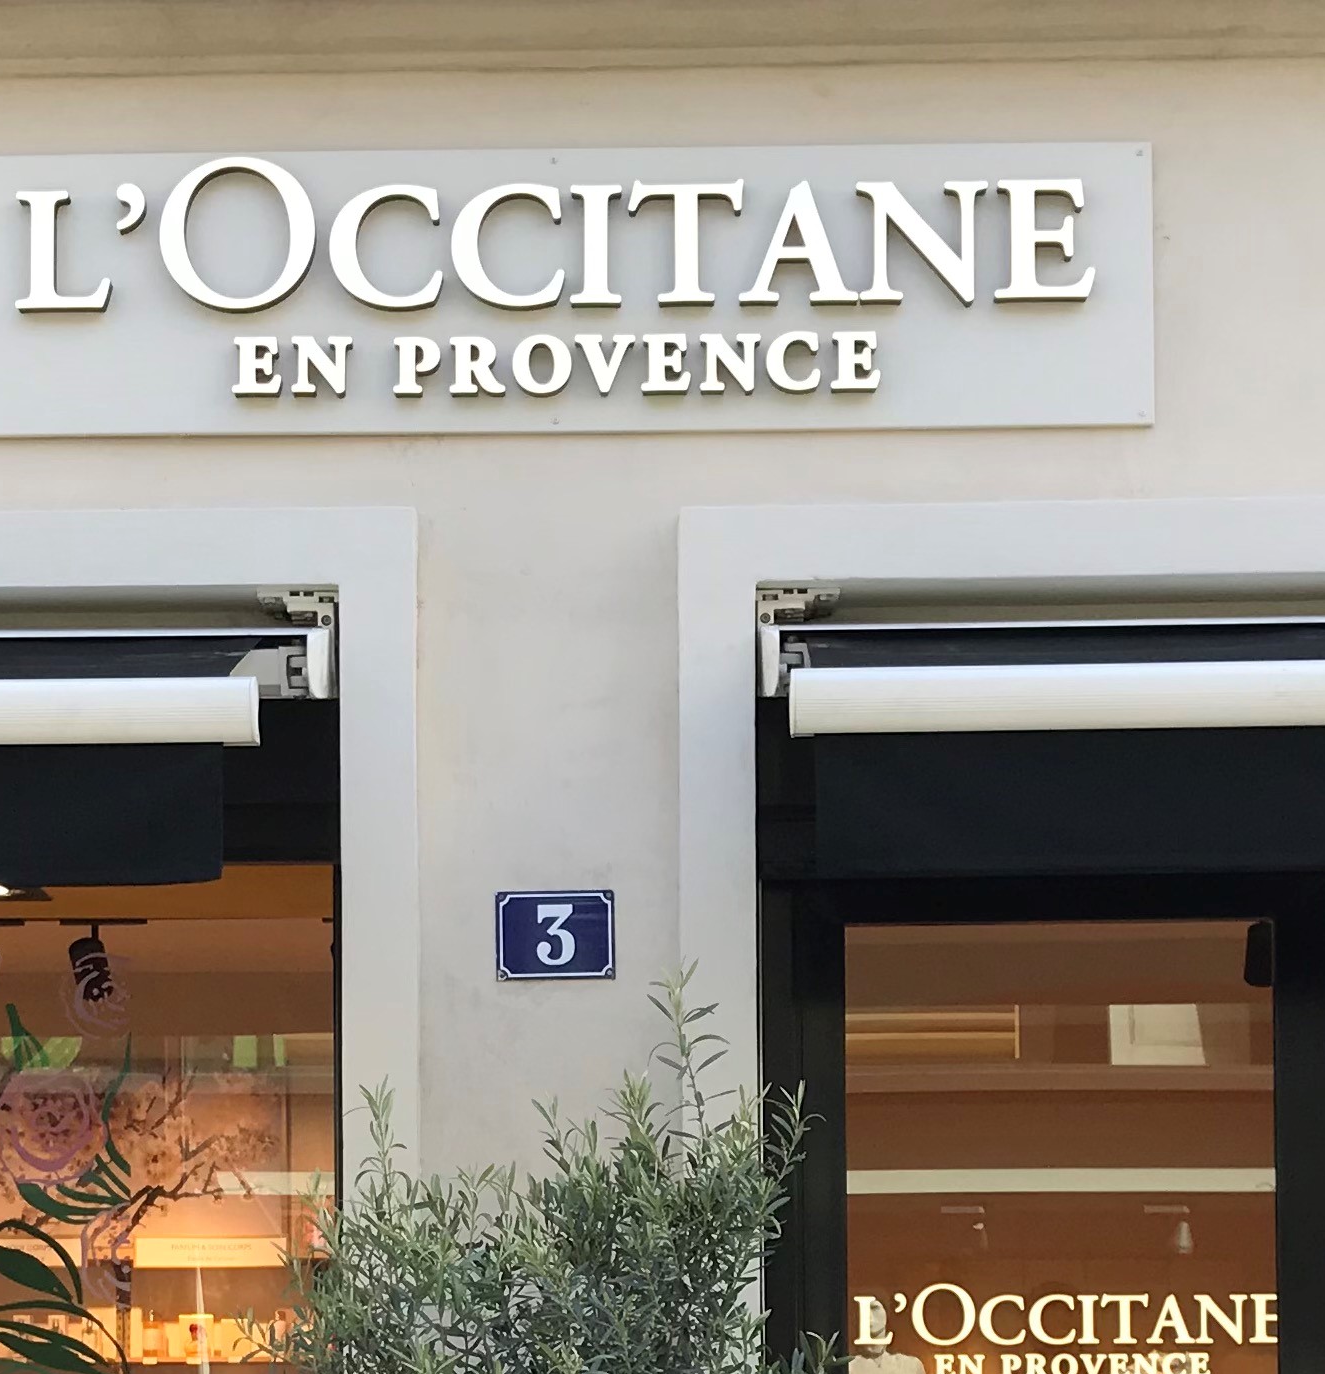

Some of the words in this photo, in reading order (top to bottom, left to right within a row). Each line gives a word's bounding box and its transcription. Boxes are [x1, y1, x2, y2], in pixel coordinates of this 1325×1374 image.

[15, 157, 1099, 316] L'OCCITANE
[230, 335, 355, 403] EN
[392, 329, 883, 400] PROVENCE
[536, 903, 576, 966] 3
[852, 1282, 1279, 1347] L'OCCITANE
